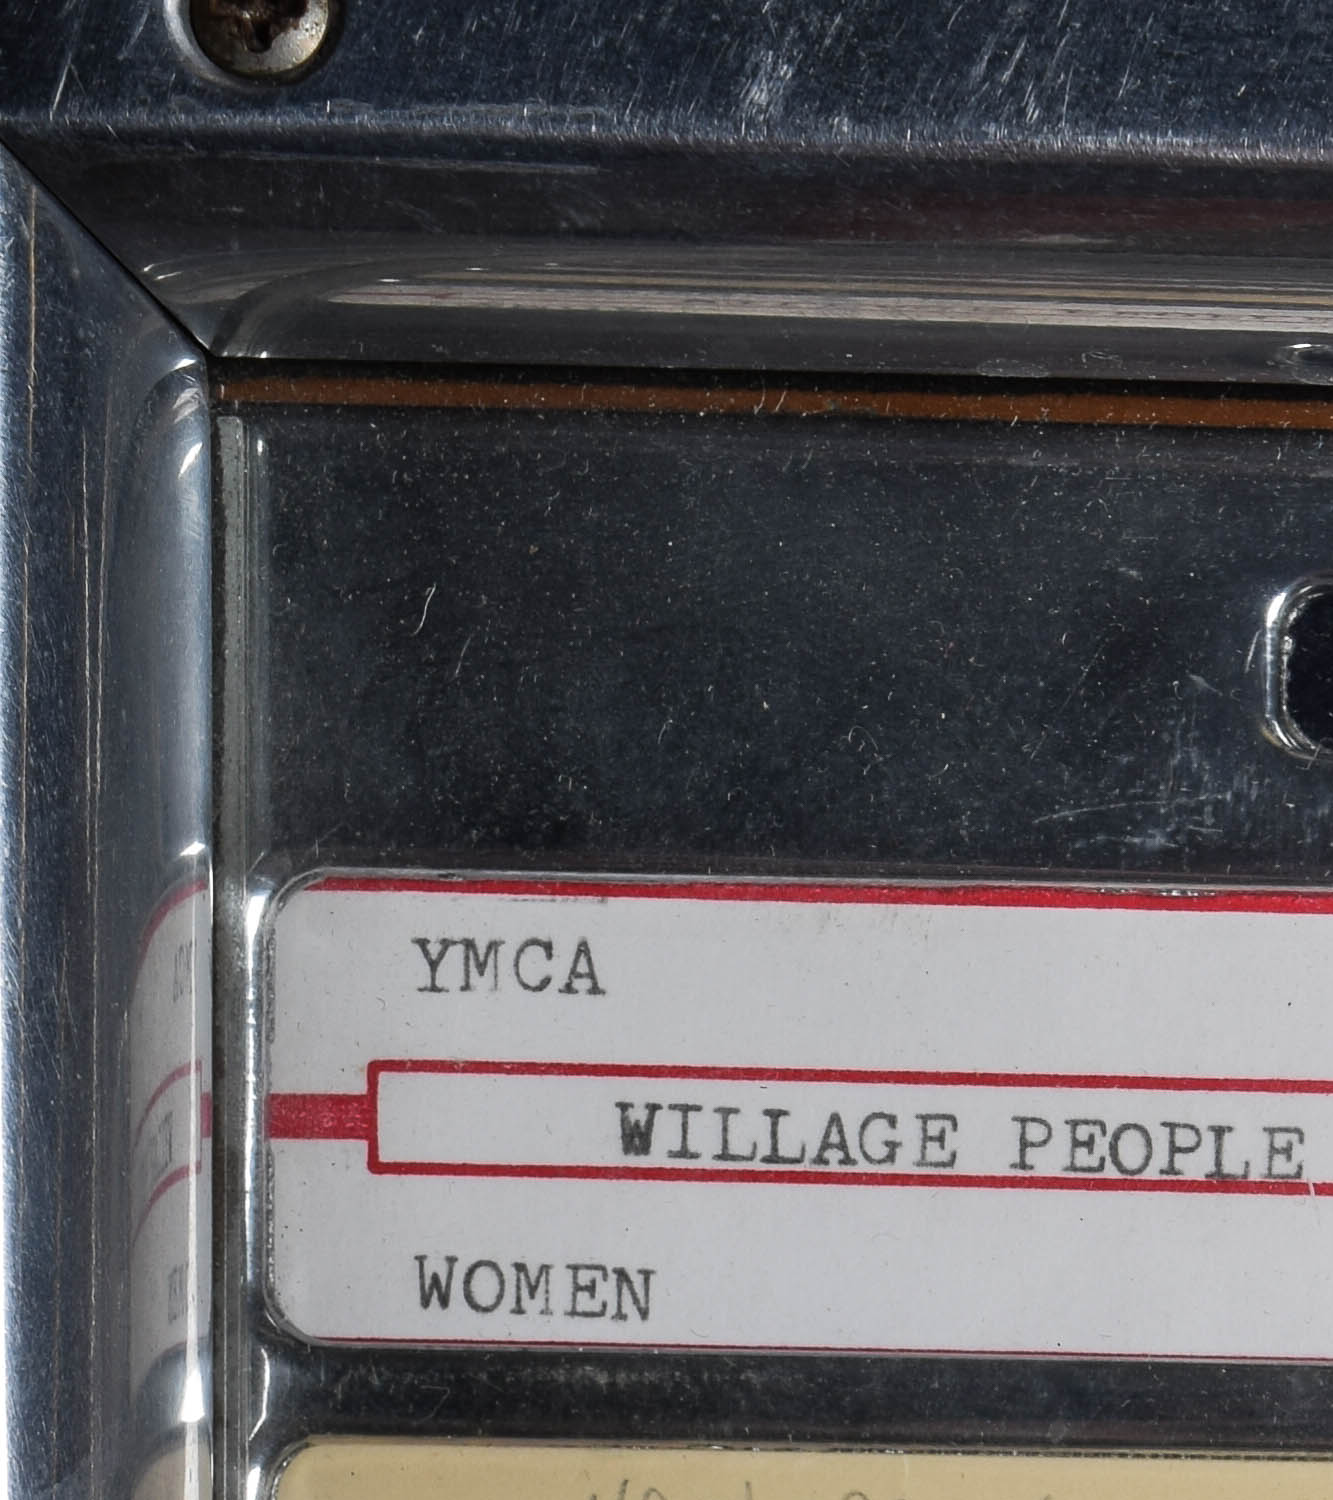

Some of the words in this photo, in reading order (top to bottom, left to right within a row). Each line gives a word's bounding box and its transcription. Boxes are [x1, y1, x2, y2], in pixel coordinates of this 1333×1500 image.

[411, 937, 607, 996] YMCA
[1009, 1116, 1305, 1180] PEOPLE
[414, 1254, 656, 1322] WOMEN
